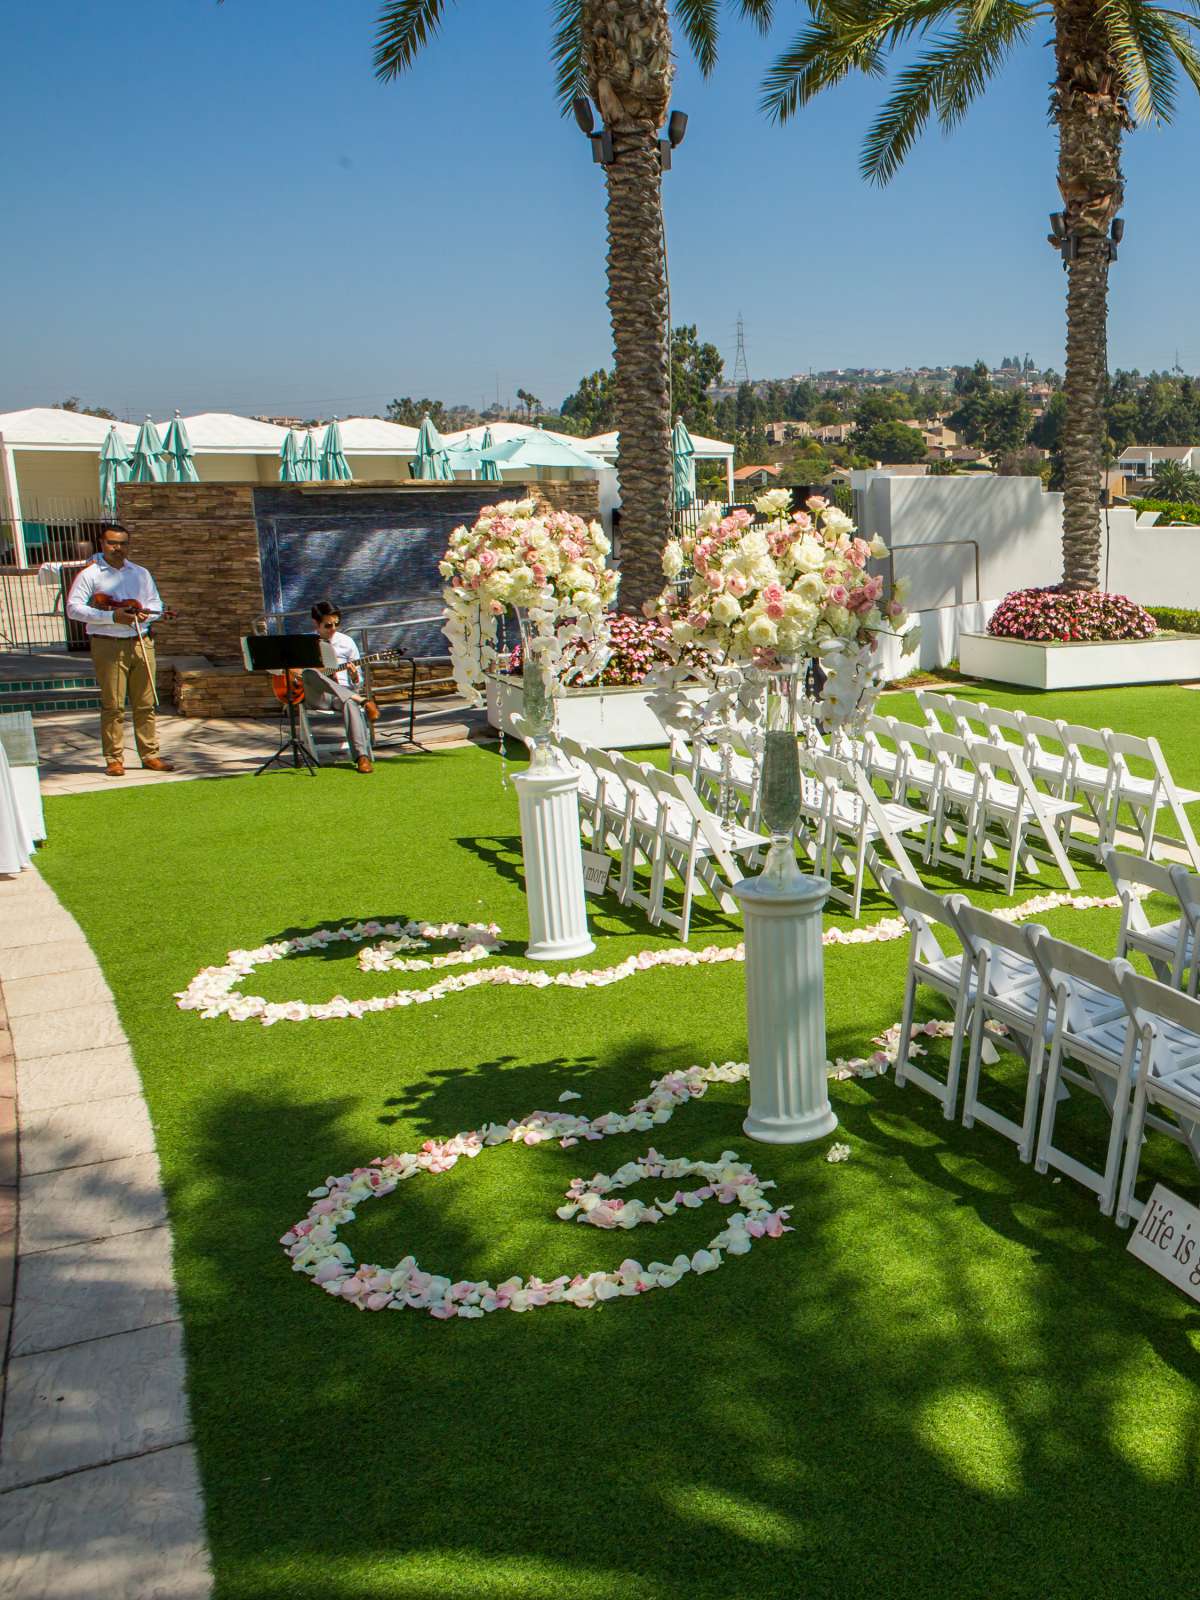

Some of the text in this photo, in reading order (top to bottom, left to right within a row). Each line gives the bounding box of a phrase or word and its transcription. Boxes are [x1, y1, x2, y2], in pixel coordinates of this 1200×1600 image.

[586, 867, 608, 884] more
[1138, 1200, 1174, 1250] life
[1172, 1223, 1196, 1265] is
